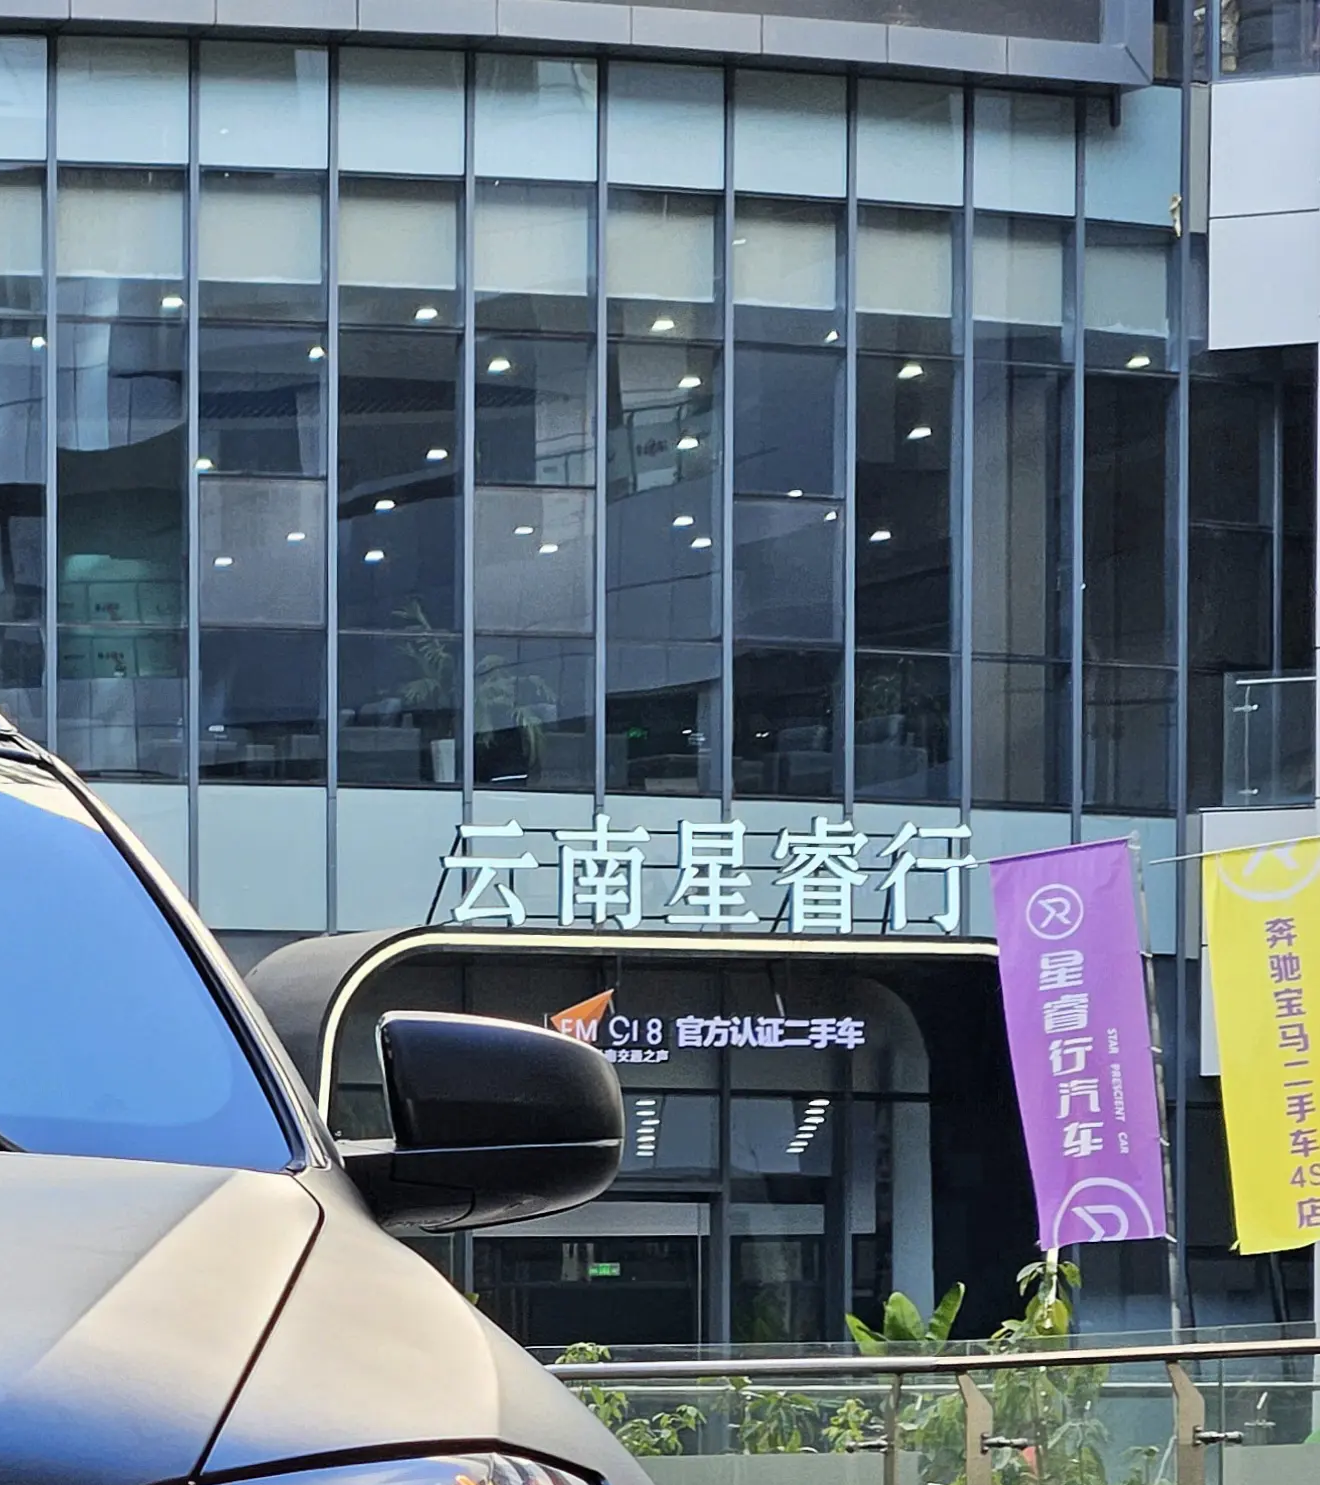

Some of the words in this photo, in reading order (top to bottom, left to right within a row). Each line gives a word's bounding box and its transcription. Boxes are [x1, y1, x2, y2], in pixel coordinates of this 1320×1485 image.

[441, 814, 979, 934] 云南星睿行
[676, 1015, 865, 1049] 官方认证二手车
